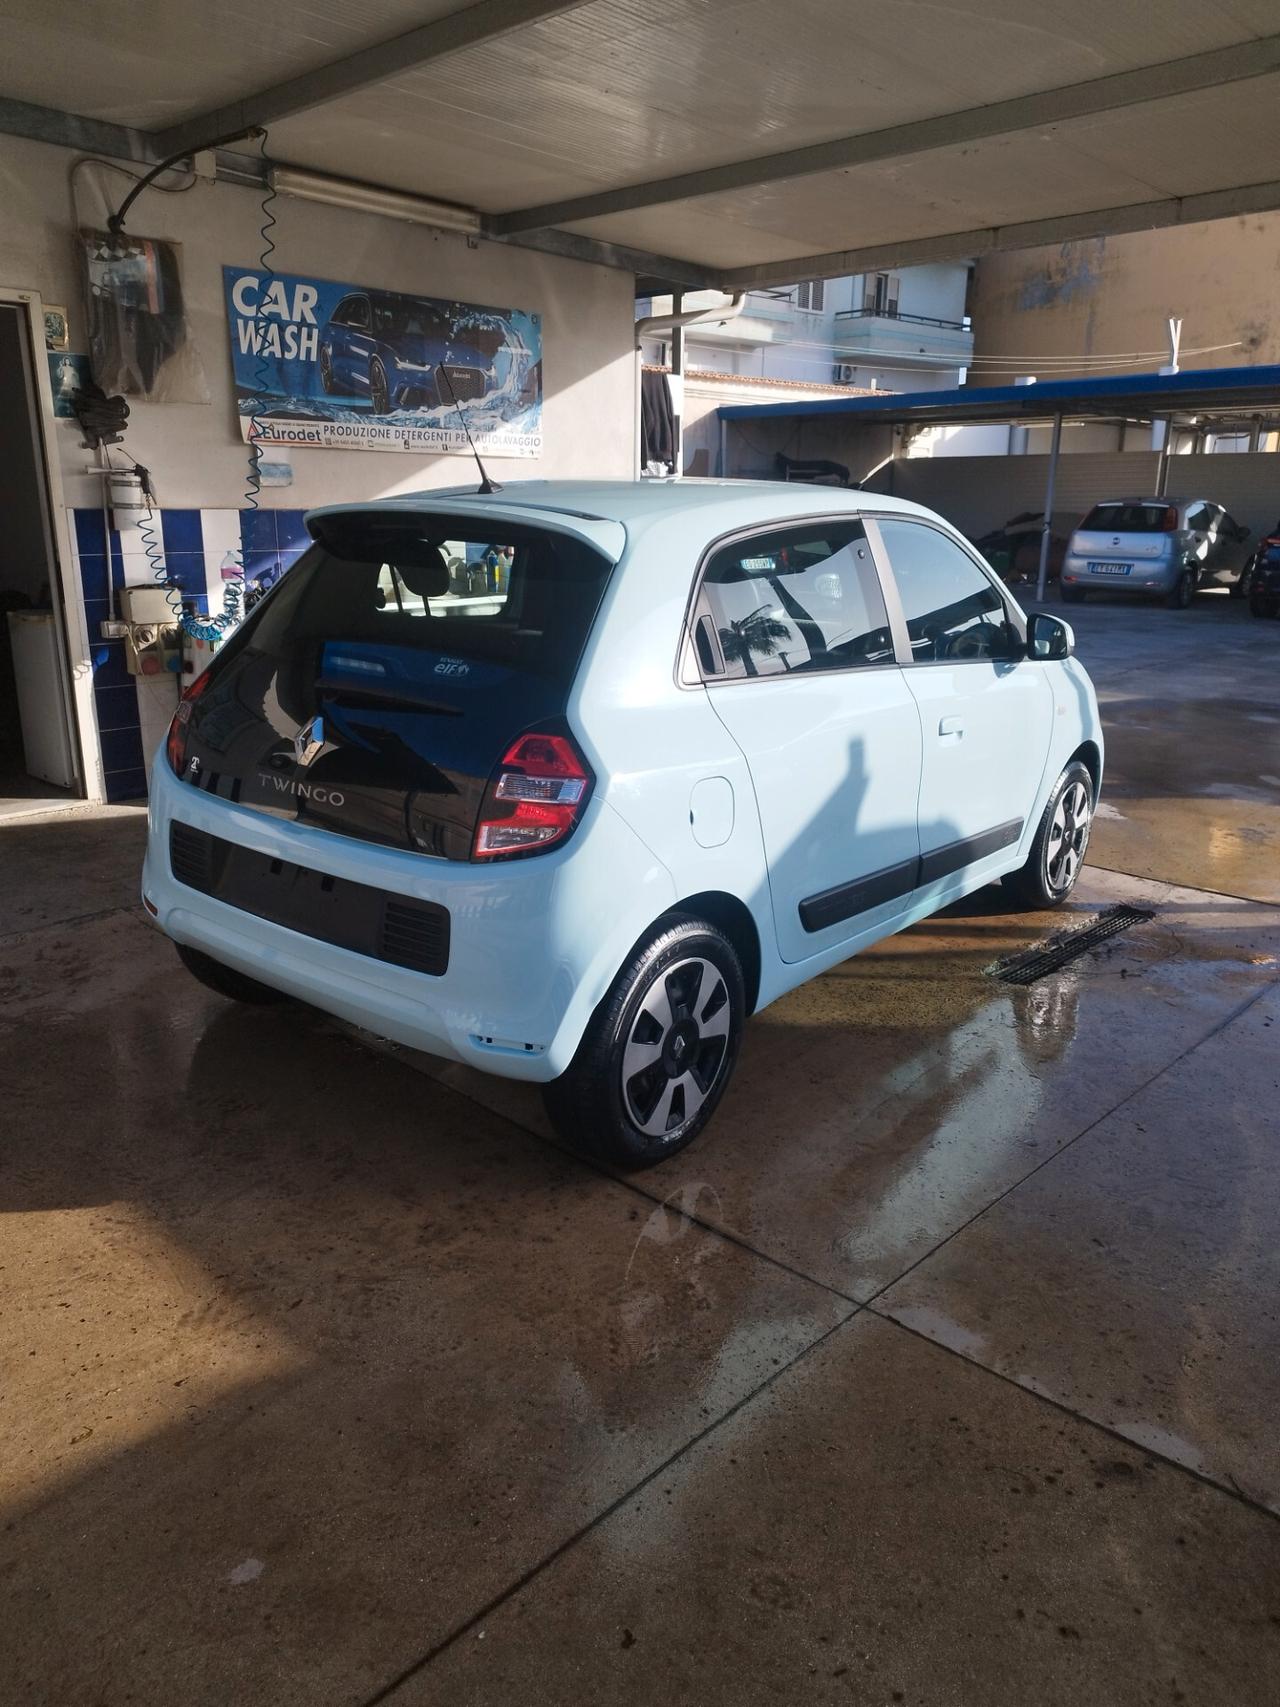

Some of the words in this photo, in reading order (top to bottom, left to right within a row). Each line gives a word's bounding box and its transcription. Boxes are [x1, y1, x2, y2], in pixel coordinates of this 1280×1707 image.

[232, 276, 318, 324] CAR
[237, 319, 319, 362] WASH
[323, 425, 391, 439] PRODUZIONE
[394, 429, 452, 442] DETERGENTI
[475, 433, 541, 447] AUTOLAVAGGIO
[258, 773, 345, 807] TWINGO
